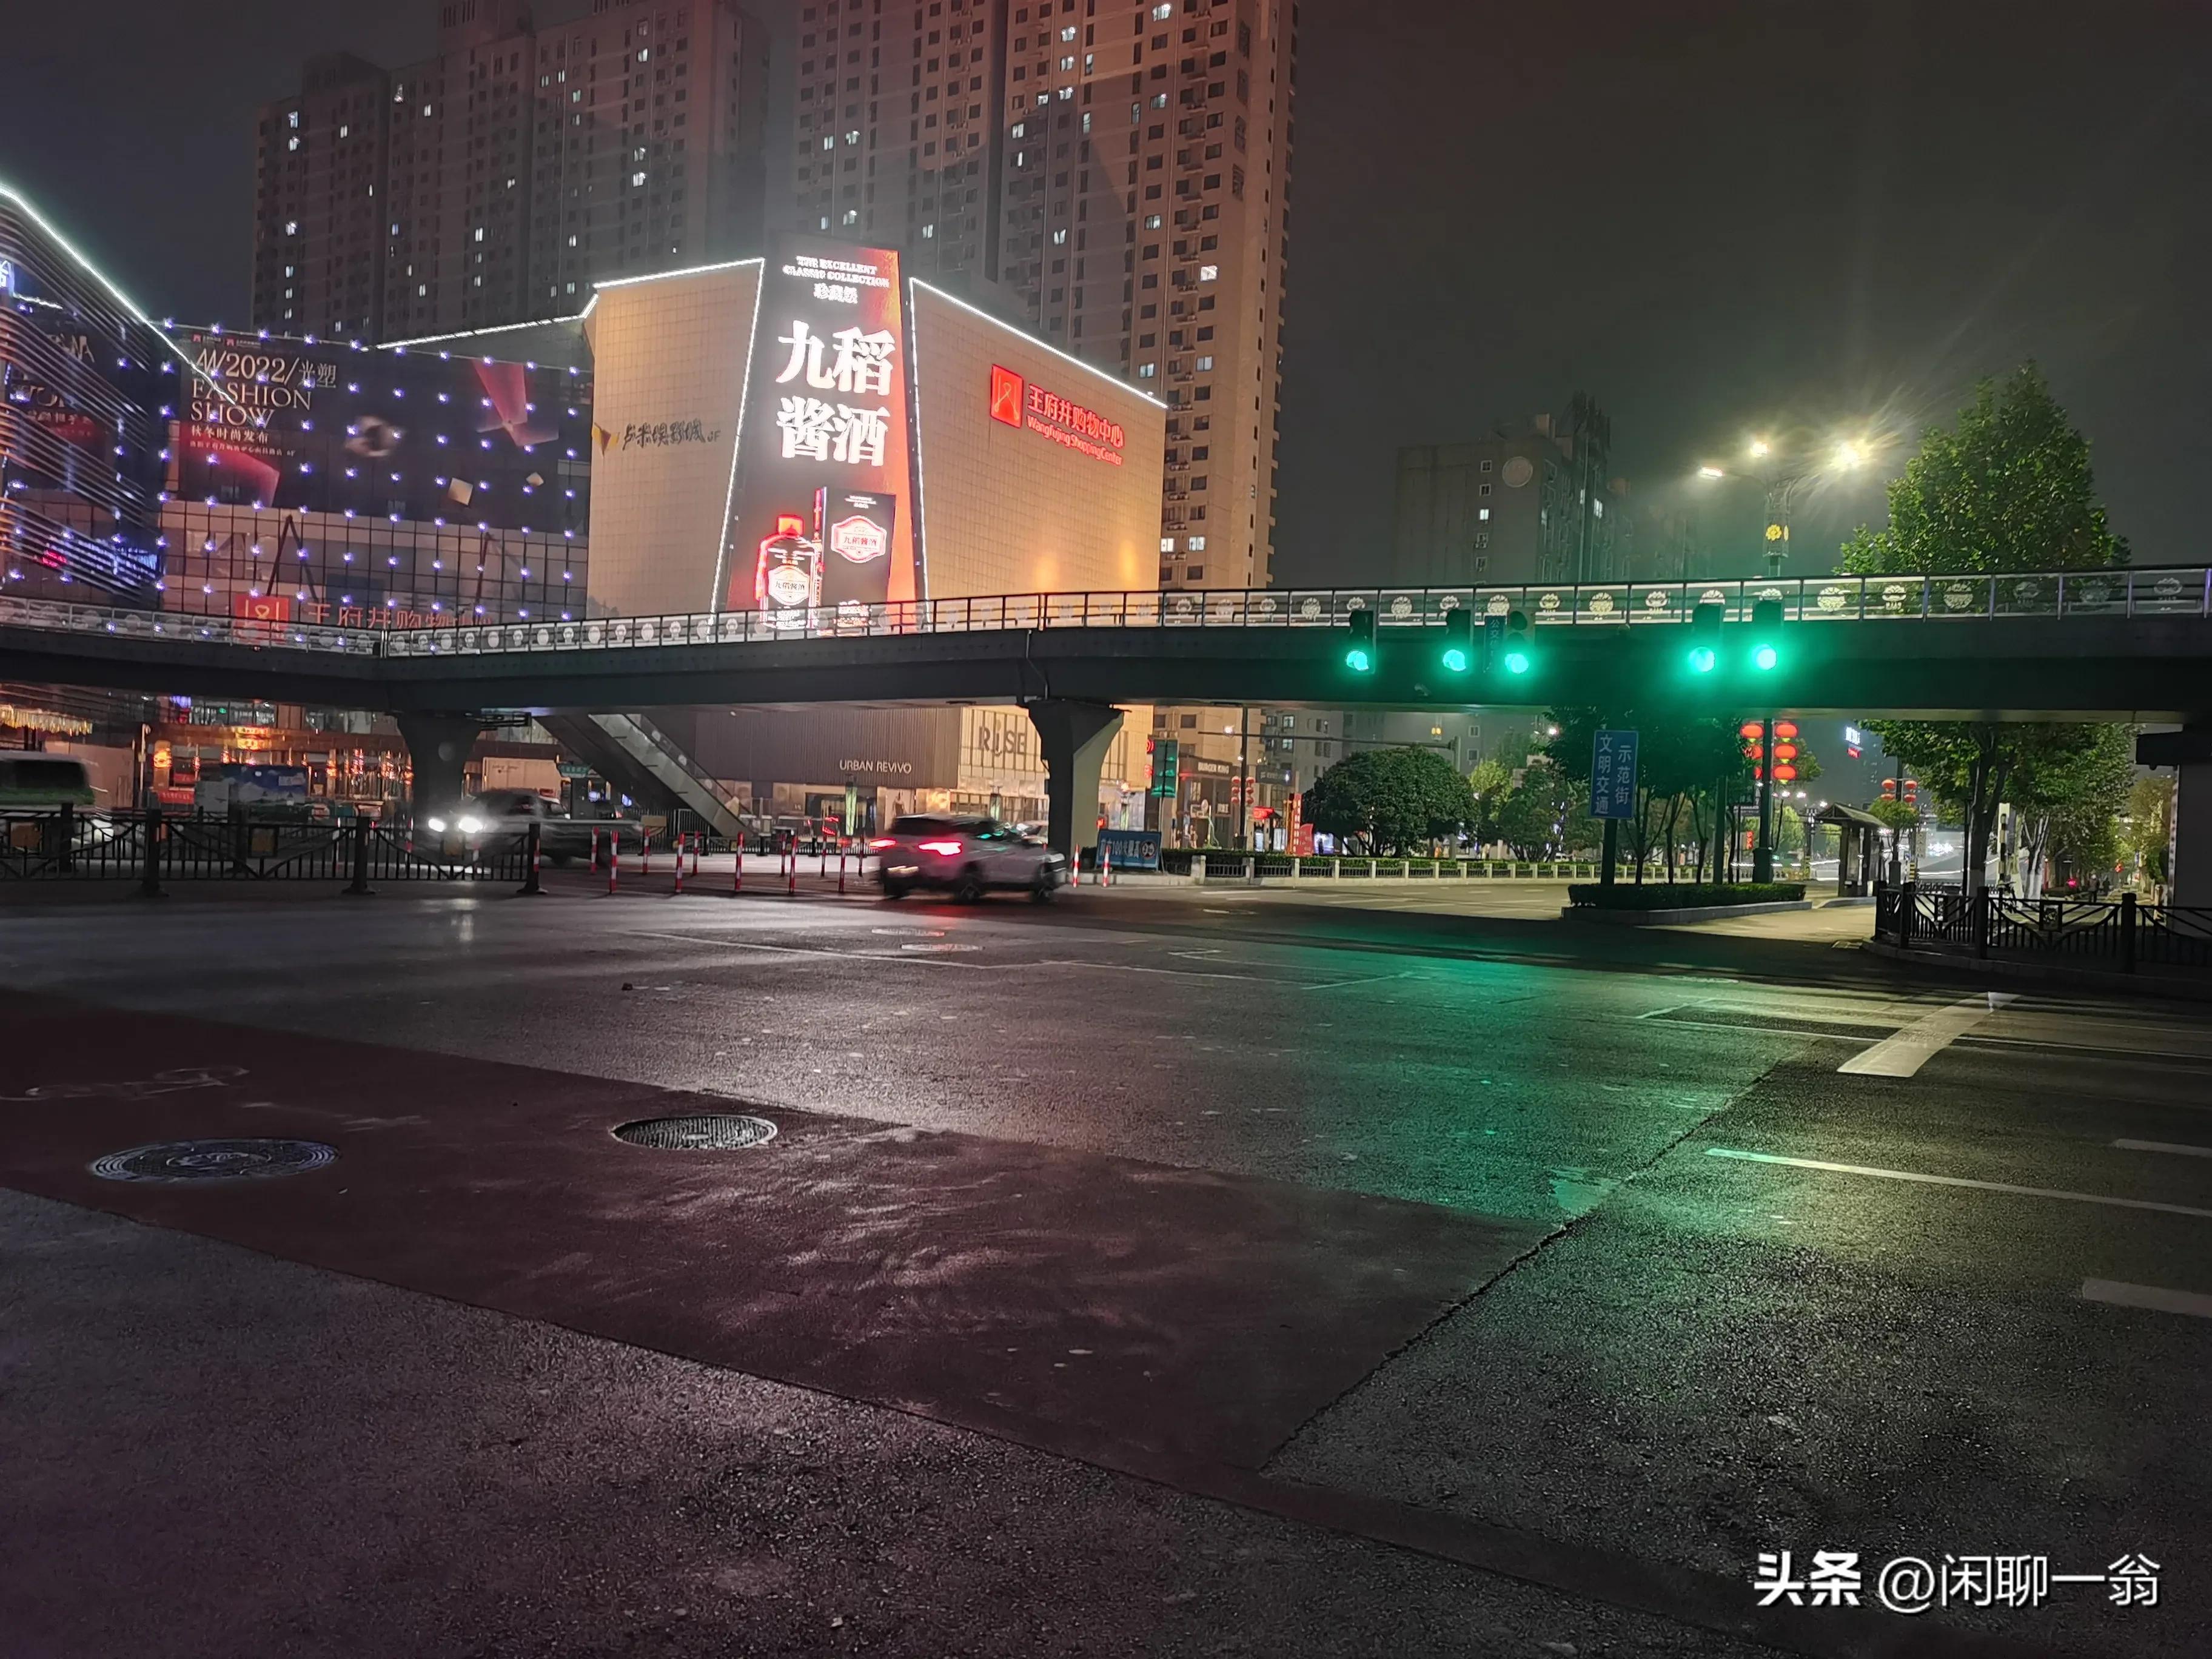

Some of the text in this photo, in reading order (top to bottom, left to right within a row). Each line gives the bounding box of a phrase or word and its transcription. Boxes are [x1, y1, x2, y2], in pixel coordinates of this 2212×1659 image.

[782, 264, 890, 288] CLASSIC COLLECTION
[796, 256, 877, 275] THE EXCELLENT
[777, 320, 896, 397] 九稻
[191, 400, 275, 429] SHOW
[192, 378, 311, 411] FASHION
[1028, 383, 1124, 449] 王府井购物中心
[776, 396, 890, 467] 酱酒
[1027, 415, 1122, 466] Wangfujing Shopping Center
[839, 759, 912, 774] URBAN REVIVO
[1595, 734, 1613, 814] 文明交通
[1615, 745, 1632, 805] 示范街
